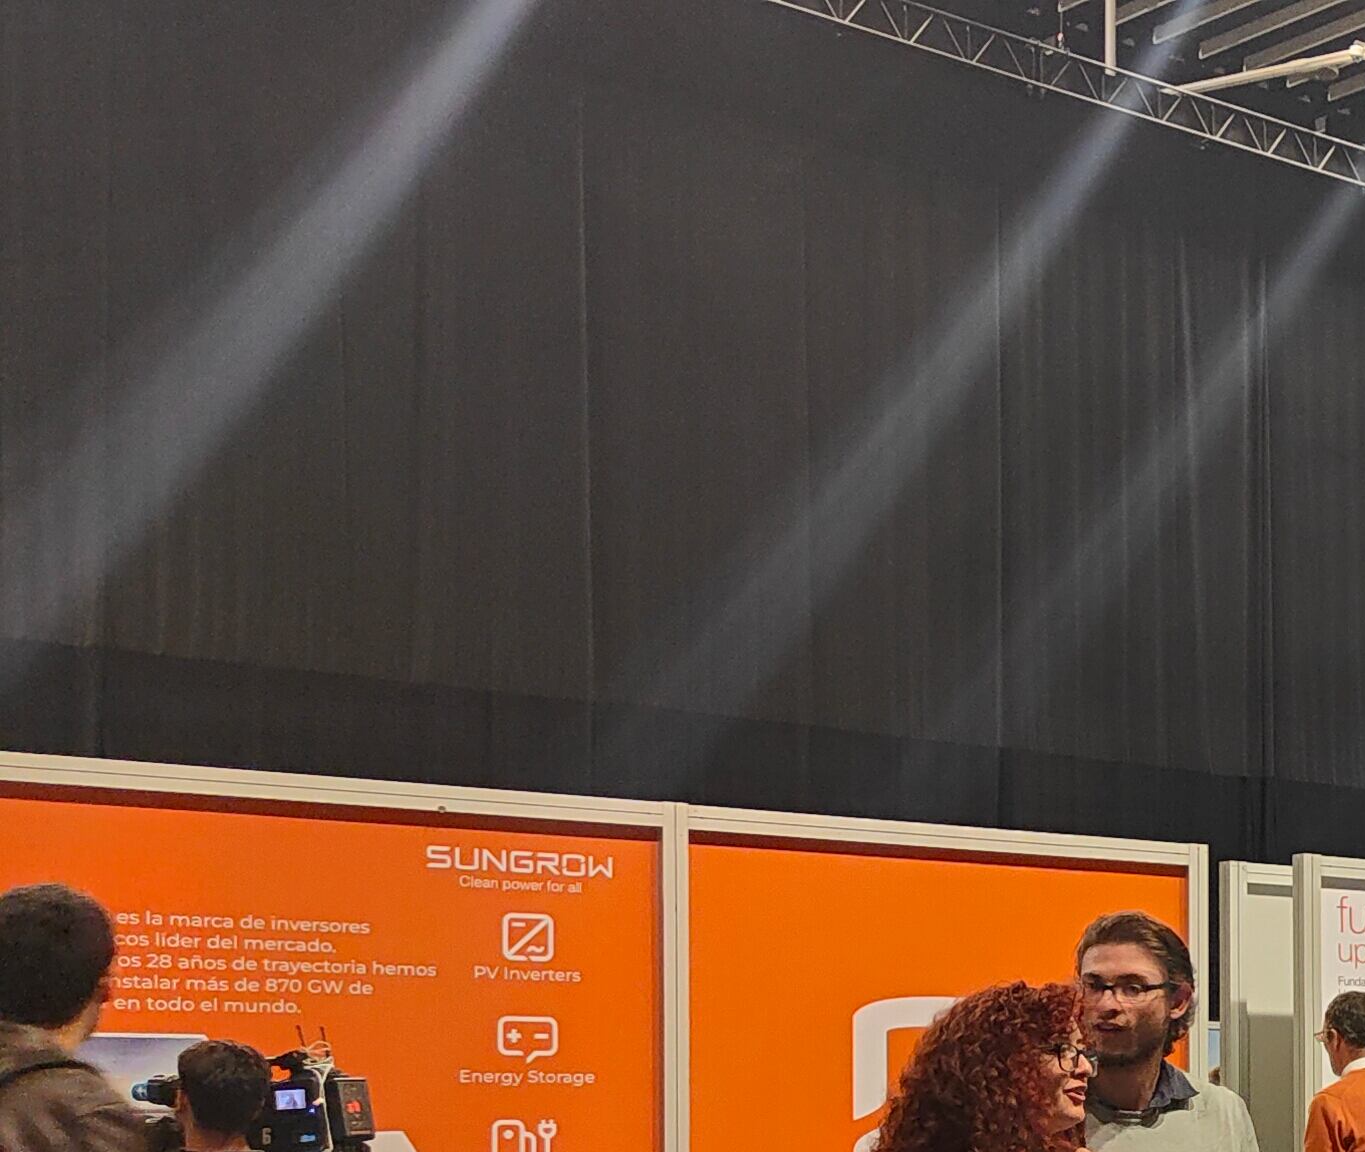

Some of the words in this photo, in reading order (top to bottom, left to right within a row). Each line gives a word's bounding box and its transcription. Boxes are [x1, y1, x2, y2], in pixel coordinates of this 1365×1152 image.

[426, 845, 614, 879] SUNGROW
[459, 875, 499, 889] Clean
[502, 880, 544, 892] power
[547, 880, 565, 893] for
[567, 882, 582, 894] all
[116, 912, 140, 925] es
[145, 910, 163, 925] la
[170, 915, 233, 928] marca
[240, 914, 265, 929] de
[271, 915, 370, 934] inversores
[113, 933, 149, 947] cos
[155, 932, 201, 948] líder
[207, 934, 238, 949] del
[244, 938, 337, 953] mercado.
[117, 955, 142, 968] os
[146, 953, 172, 969] 28
[178, 955, 227, 970] años
[232, 956, 257, 971] de
[264, 959, 367, 976] trayectoria
[372, 961, 437, 977] hemos
[474, 965, 500, 980] PV
[504, 966, 581, 983] Inverters
[109, 974, 180, 990] nstalar
[186, 977, 229, 991] más
[234, 978, 260, 992] de
[265, 978, 302, 993] 870
[307, 980, 344, 994] GW
[348, 980, 374, 995] de
[114, 998, 141, 1010] en
[146, 996, 195, 1012] todo
[200, 997, 218, 1012] el
[224, 999, 302, 1014] mundo.
[459, 1069, 523, 1087] Energy
[527, 1070, 596, 1087] Storage
